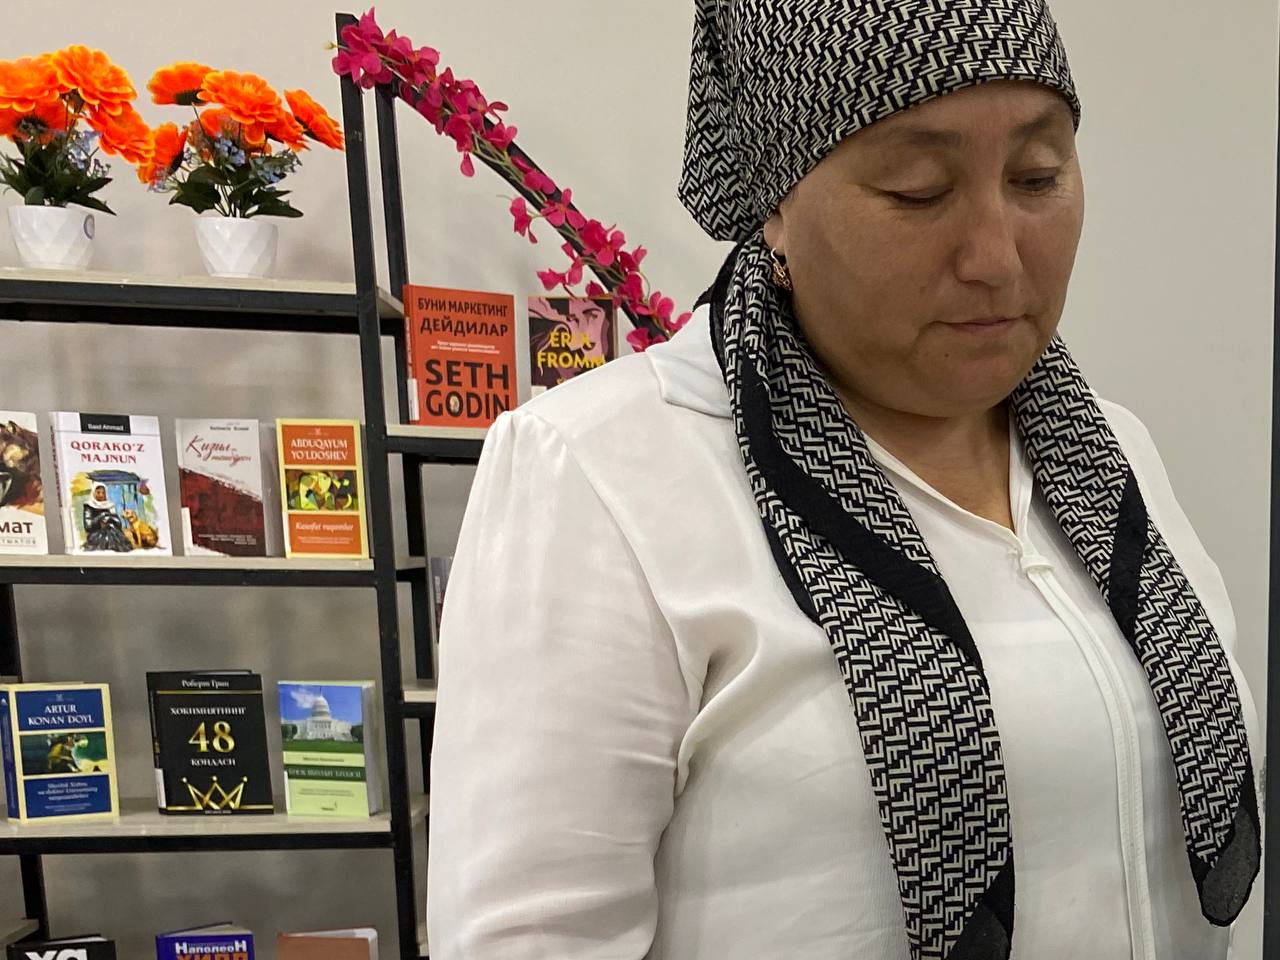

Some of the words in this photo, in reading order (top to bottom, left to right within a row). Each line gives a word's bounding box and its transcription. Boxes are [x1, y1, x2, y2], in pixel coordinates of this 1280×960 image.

[418, 297, 447, 311] БУНИ
[449, 300, 509, 317] МАРКЕТИНГ
[420, 316, 509, 338] ДЕЙДИЛАР
[425, 358, 509, 390] SETH
[425, 389, 510, 420] GODIN
[291, 438, 348, 449] ABDUQAYUM
[81, 453, 137, 464] MAJNUN
[44, 704, 77, 714] ARTUR
[28, 716, 65, 726] KONAN
[68, 714, 95, 724] DOYL
[188, 720, 235, 753] 48
